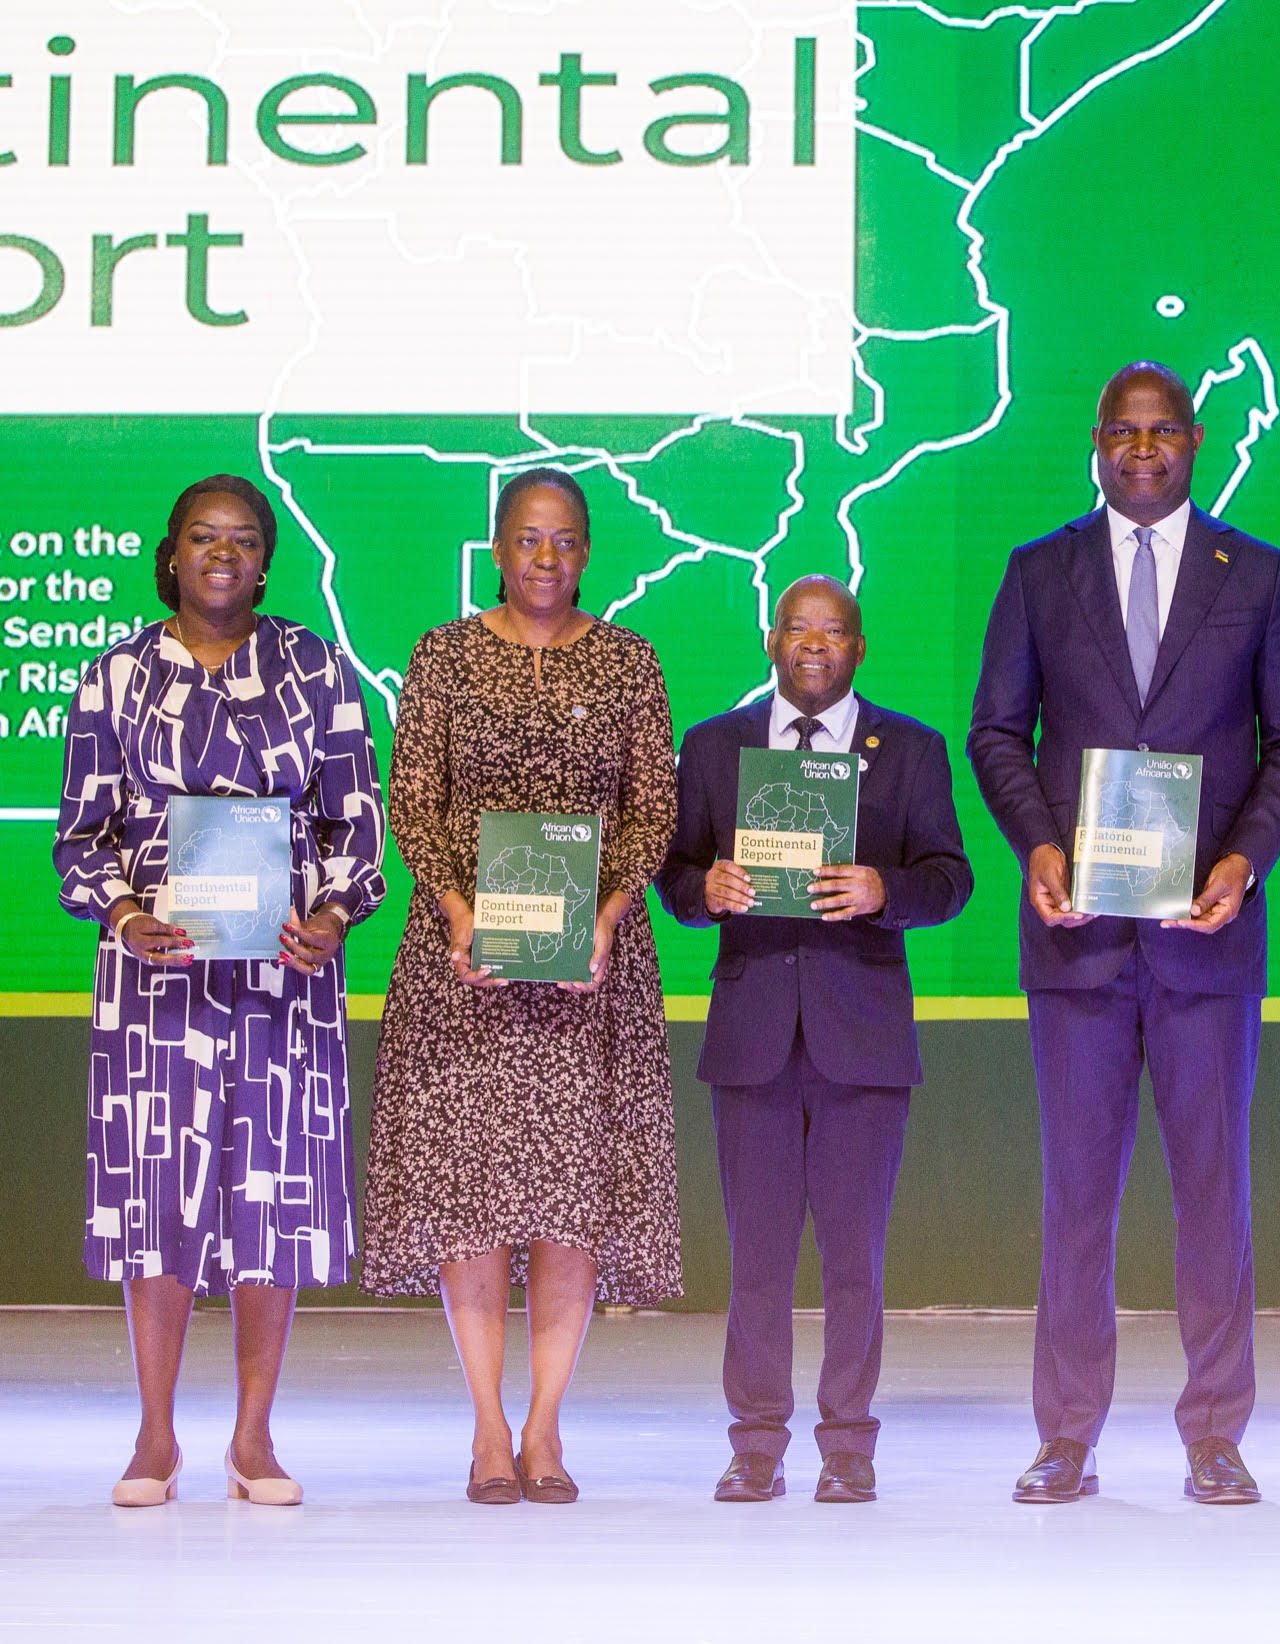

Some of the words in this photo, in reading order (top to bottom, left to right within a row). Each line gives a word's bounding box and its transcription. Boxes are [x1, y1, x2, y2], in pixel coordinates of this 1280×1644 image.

[10, 531, 64, 558] on
[74, 524, 142, 558] the
[46, 569, 114, 602] the
[800, 760, 831, 771] African
[804, 769, 831, 779] Union
[1135, 768, 1172, 779] Africana
[230, 804, 262, 815] African
[235, 814, 262, 823] Union
[540, 822, 572, 833] African
[545, 832, 572, 842] Union
[1079, 830, 1133, 842] Rlatório
[741, 836, 817, 851] Continental
[1078, 842, 1148, 857] Cntinental
[740, 848, 783, 862] Report
[174, 881, 252, 893] Continental
[174, 894, 218, 907] Report
[480, 899, 558, 913] Continental
[480, 912, 524, 926] Report
